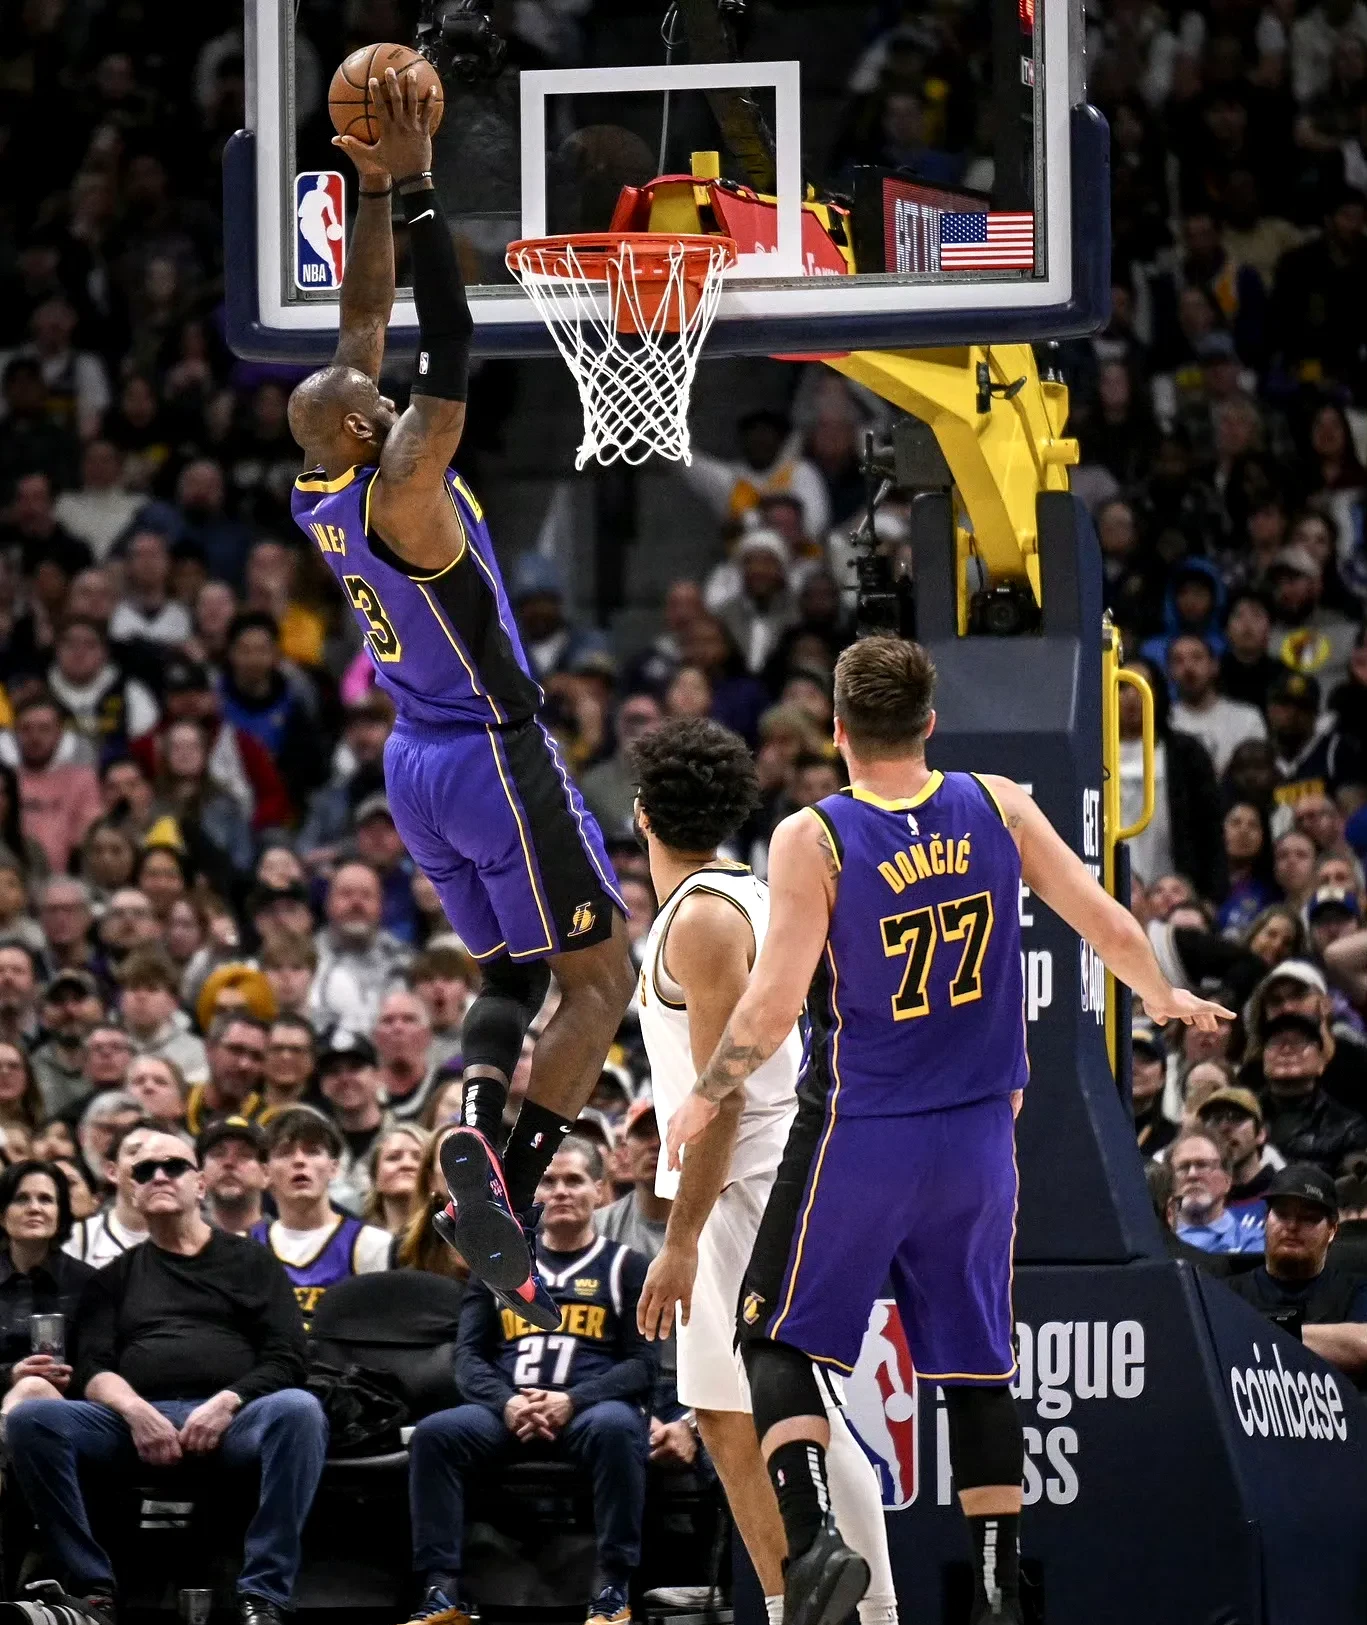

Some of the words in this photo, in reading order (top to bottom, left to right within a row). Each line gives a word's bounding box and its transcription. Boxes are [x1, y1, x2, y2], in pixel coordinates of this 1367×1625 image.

[302, 263, 327, 283] NBA
[342, 575, 402, 663] 3
[1083, 788, 1099, 857] GET
[876, 832, 973, 895] DONČIĆ
[879, 890, 994, 1022] 77
[513, 1335, 577, 1386] 27
[937, 1320, 1145, 1420] ague
[1230, 1342, 1348, 1442] coinbase
